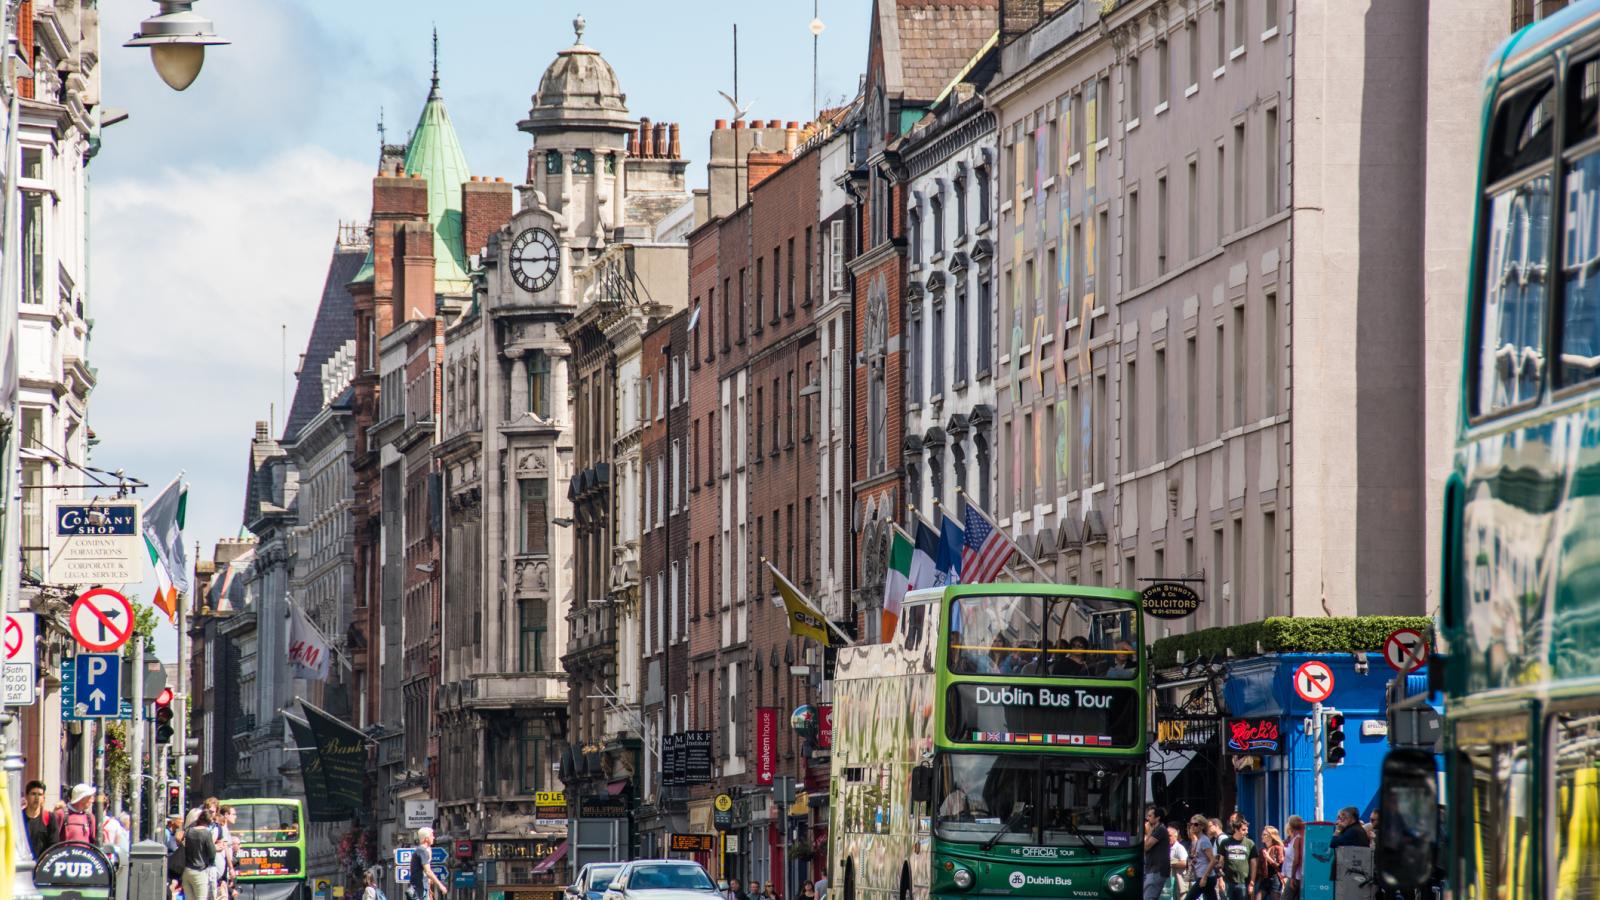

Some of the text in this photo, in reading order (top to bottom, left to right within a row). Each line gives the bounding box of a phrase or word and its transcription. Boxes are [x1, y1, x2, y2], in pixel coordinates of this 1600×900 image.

[83, 507, 110, 515] TE
[61, 510, 132, 529] COANY
[78, 526, 115, 534] SHOP
[1142, 599, 1197, 608] SOLICITORS
[288, 640, 320, 667] H&M
[87, 656, 108, 685] P
[7, 692, 22, 700] SAT
[975, 686, 1113, 708] Dublin Bus Tour
[536, 792, 566, 801] TO LET
[236, 847, 288, 858] lin Bus Tour
[402, 852, 410, 861] P
[1022, 847, 1058, 857] OFFICIAL
[53, 861, 93, 878] PUB
[400, 869, 409, 880] P
[1026, 875, 1072, 886] Dublin Bus
